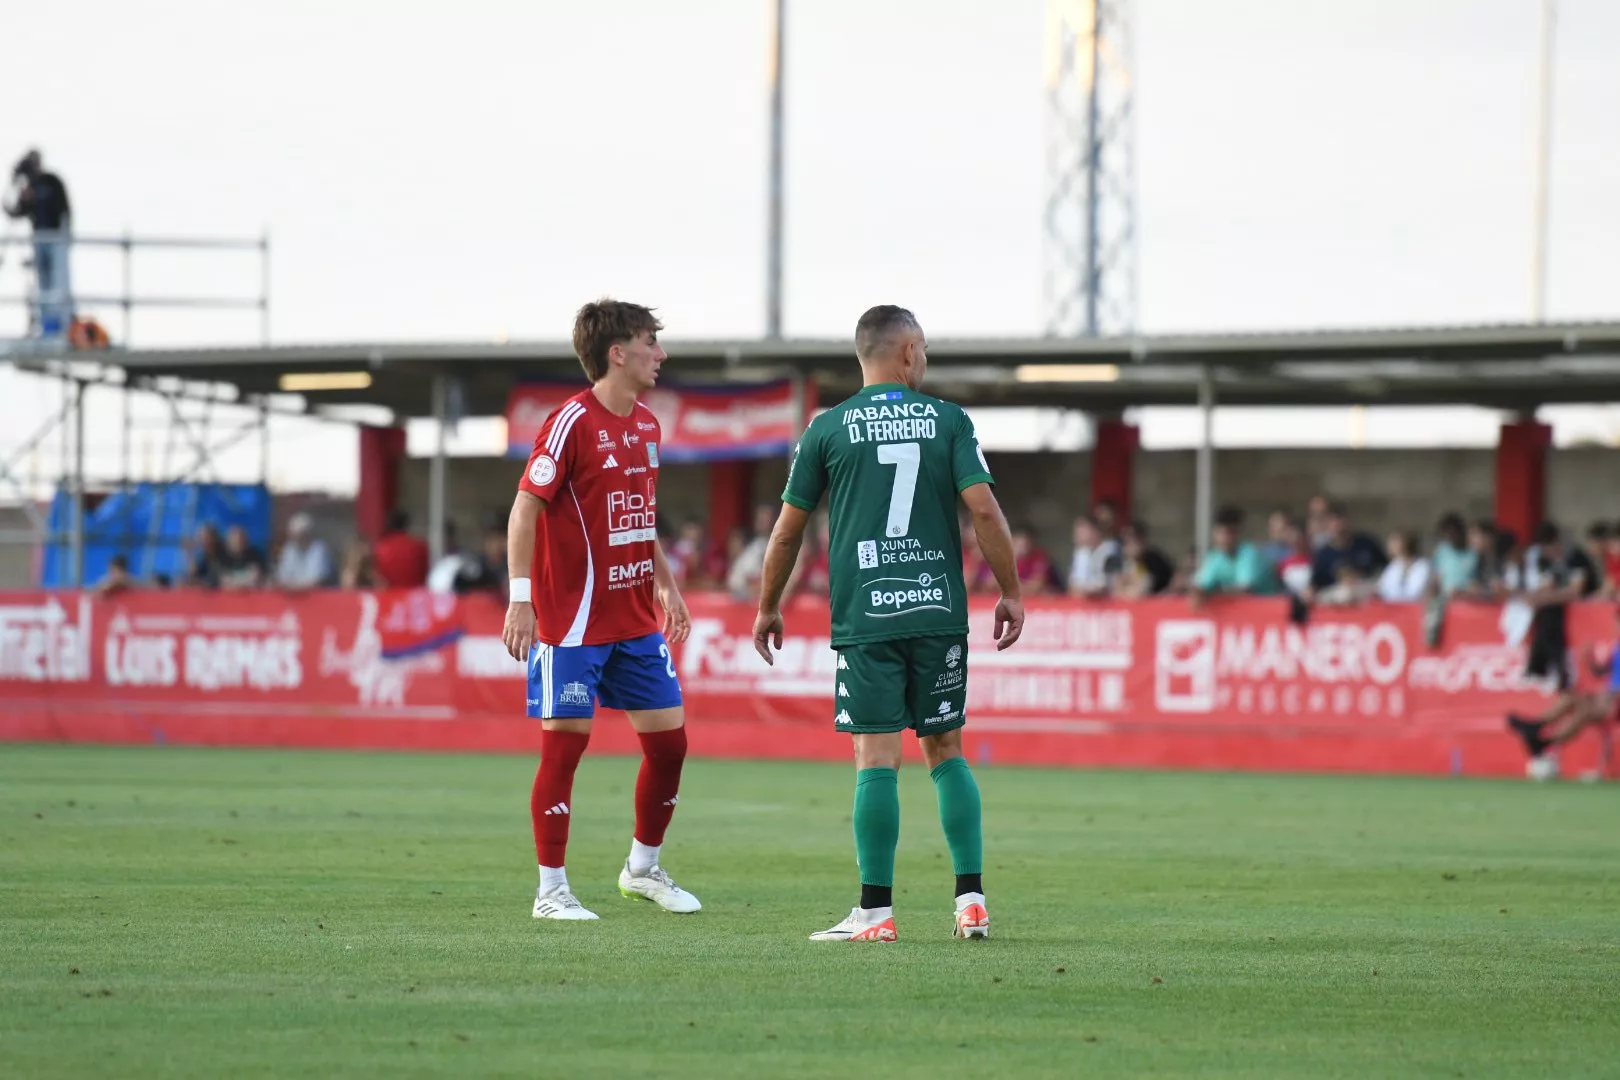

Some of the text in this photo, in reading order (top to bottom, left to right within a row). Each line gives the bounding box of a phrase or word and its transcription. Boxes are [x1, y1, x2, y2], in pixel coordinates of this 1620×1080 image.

[848, 418, 936, 443] D. FERREIRO
[877, 442, 920, 538] 7
[881, 538, 922, 551] XUNTA
[881, 550, 945, 564] DE GALICIA
[870, 588, 943, 609] Bopeixe
[658, 645, 677, 679] 2
[560, 694, 591, 704] BRUJAS
